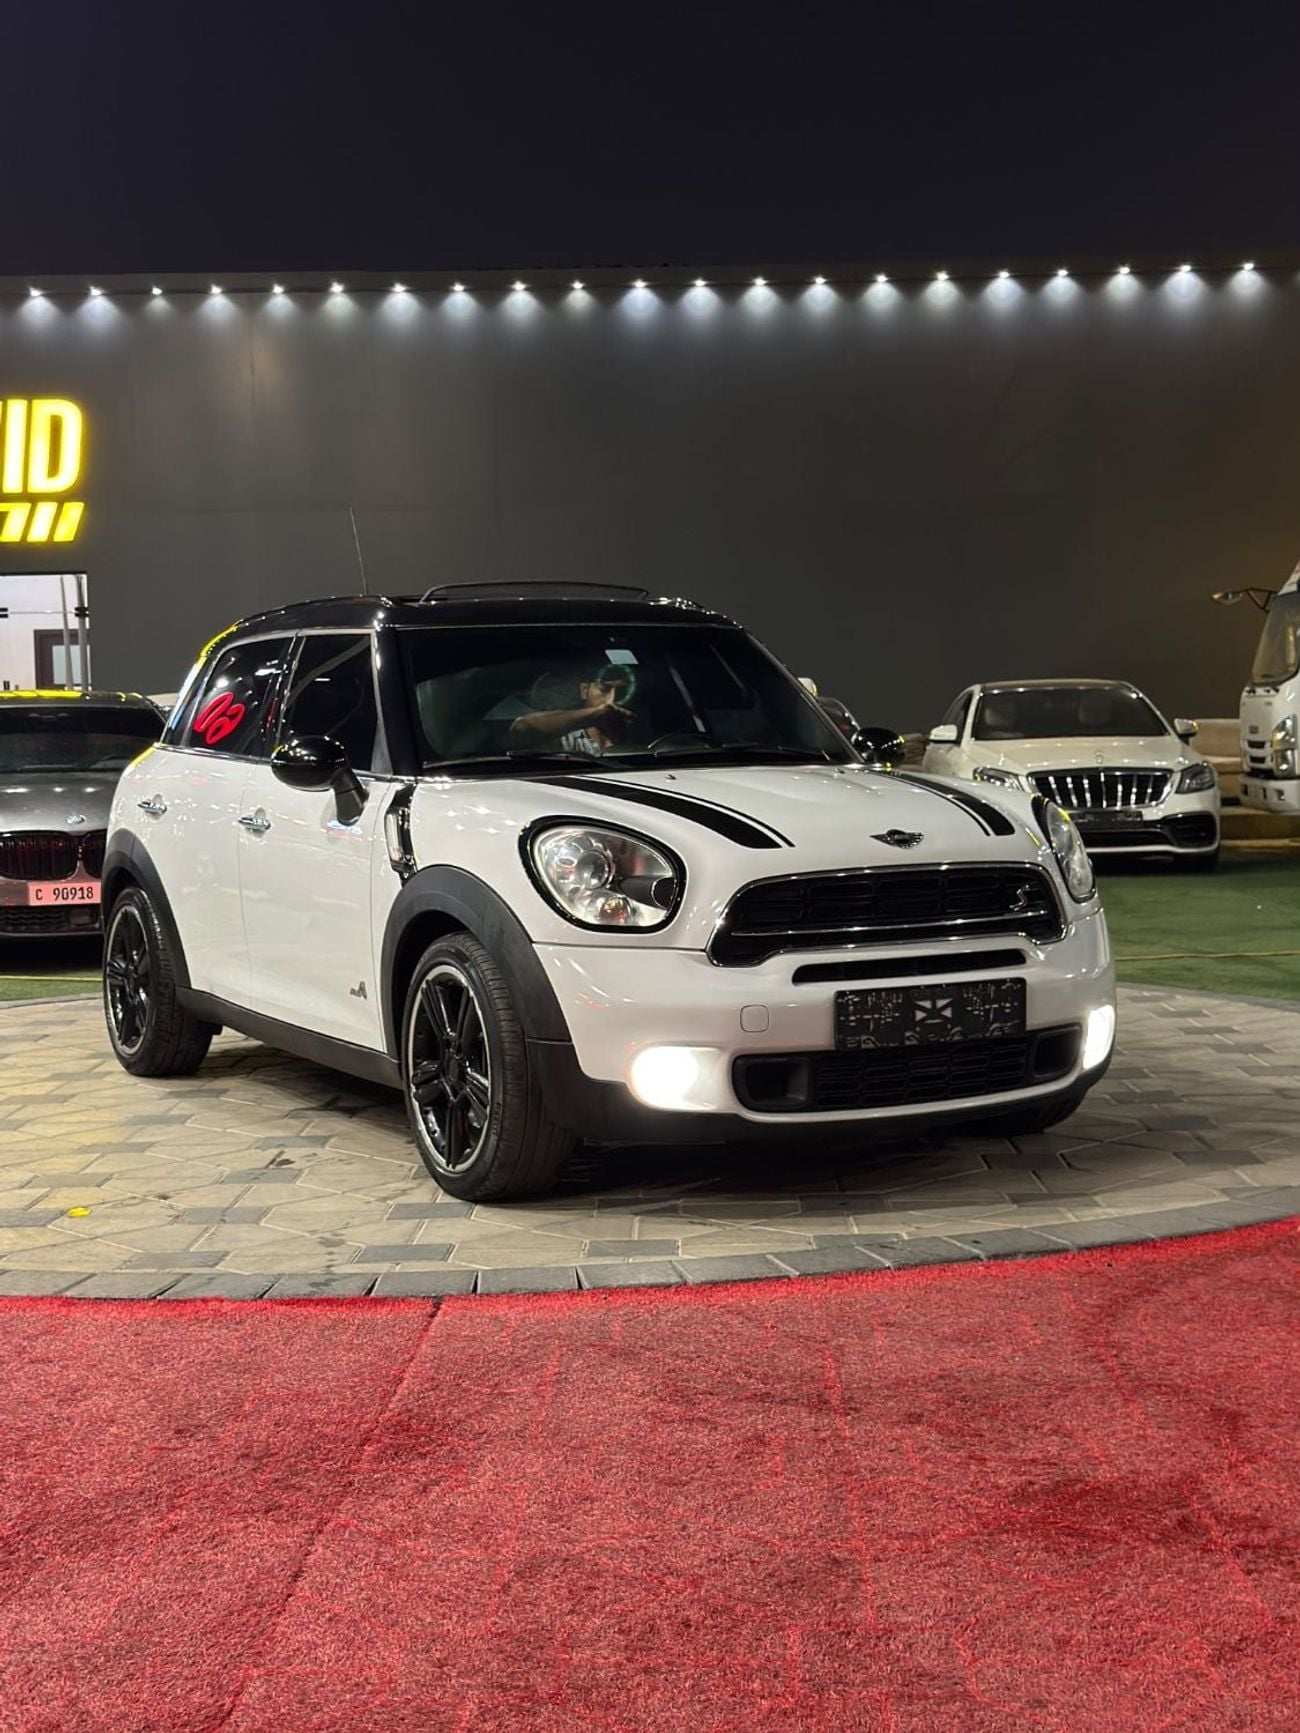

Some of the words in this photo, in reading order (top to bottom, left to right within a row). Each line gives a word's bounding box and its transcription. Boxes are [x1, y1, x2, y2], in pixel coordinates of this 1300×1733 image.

[0, 399, 83, 494] ID
[35, 889, 43, 900] C
[53, 886, 94, 901] 90918
